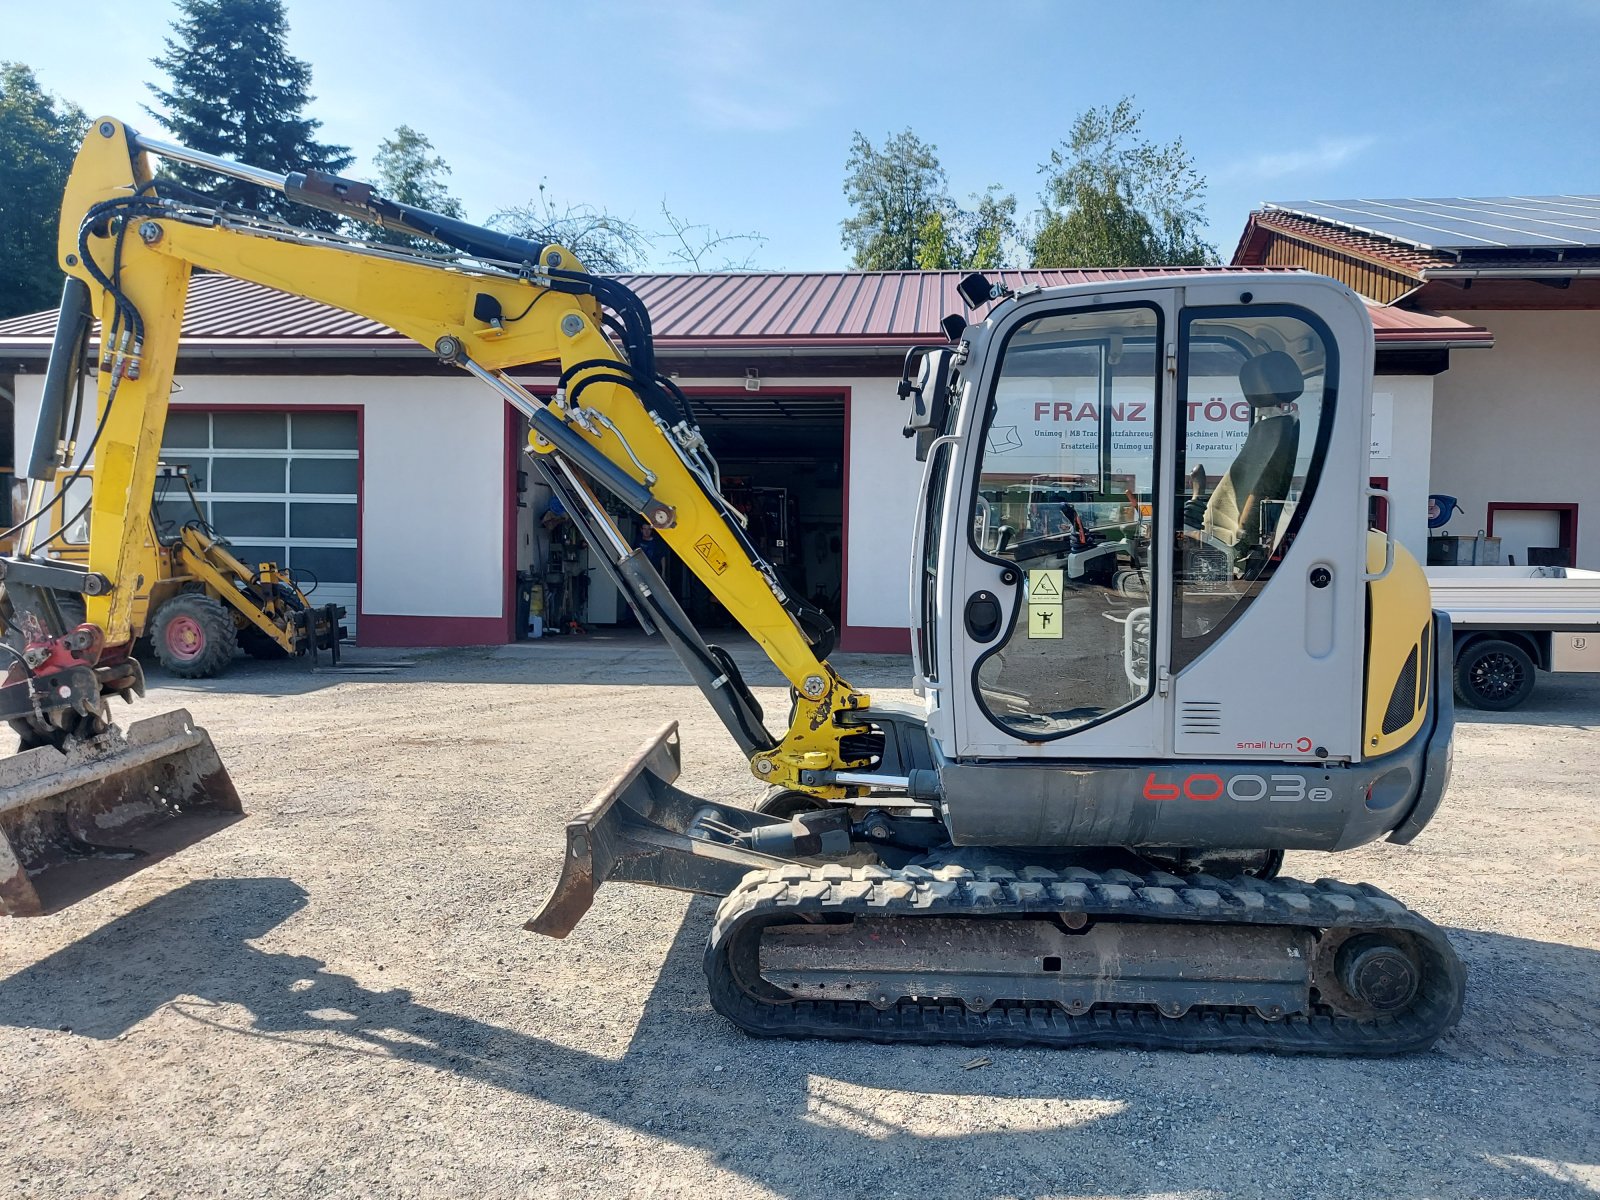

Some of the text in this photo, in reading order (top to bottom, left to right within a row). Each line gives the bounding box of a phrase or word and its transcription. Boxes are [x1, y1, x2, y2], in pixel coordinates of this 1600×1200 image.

[1034, 402, 1146, 421] FRANZ
[1034, 430, 1063, 438] Unimog
[1110, 430, 1154, 438] utzfahrzeug
[1113, 443, 1142, 451] Unimog
[1195, 443, 1233, 451] Reparatur
[1236, 741, 1293, 749] small turn
